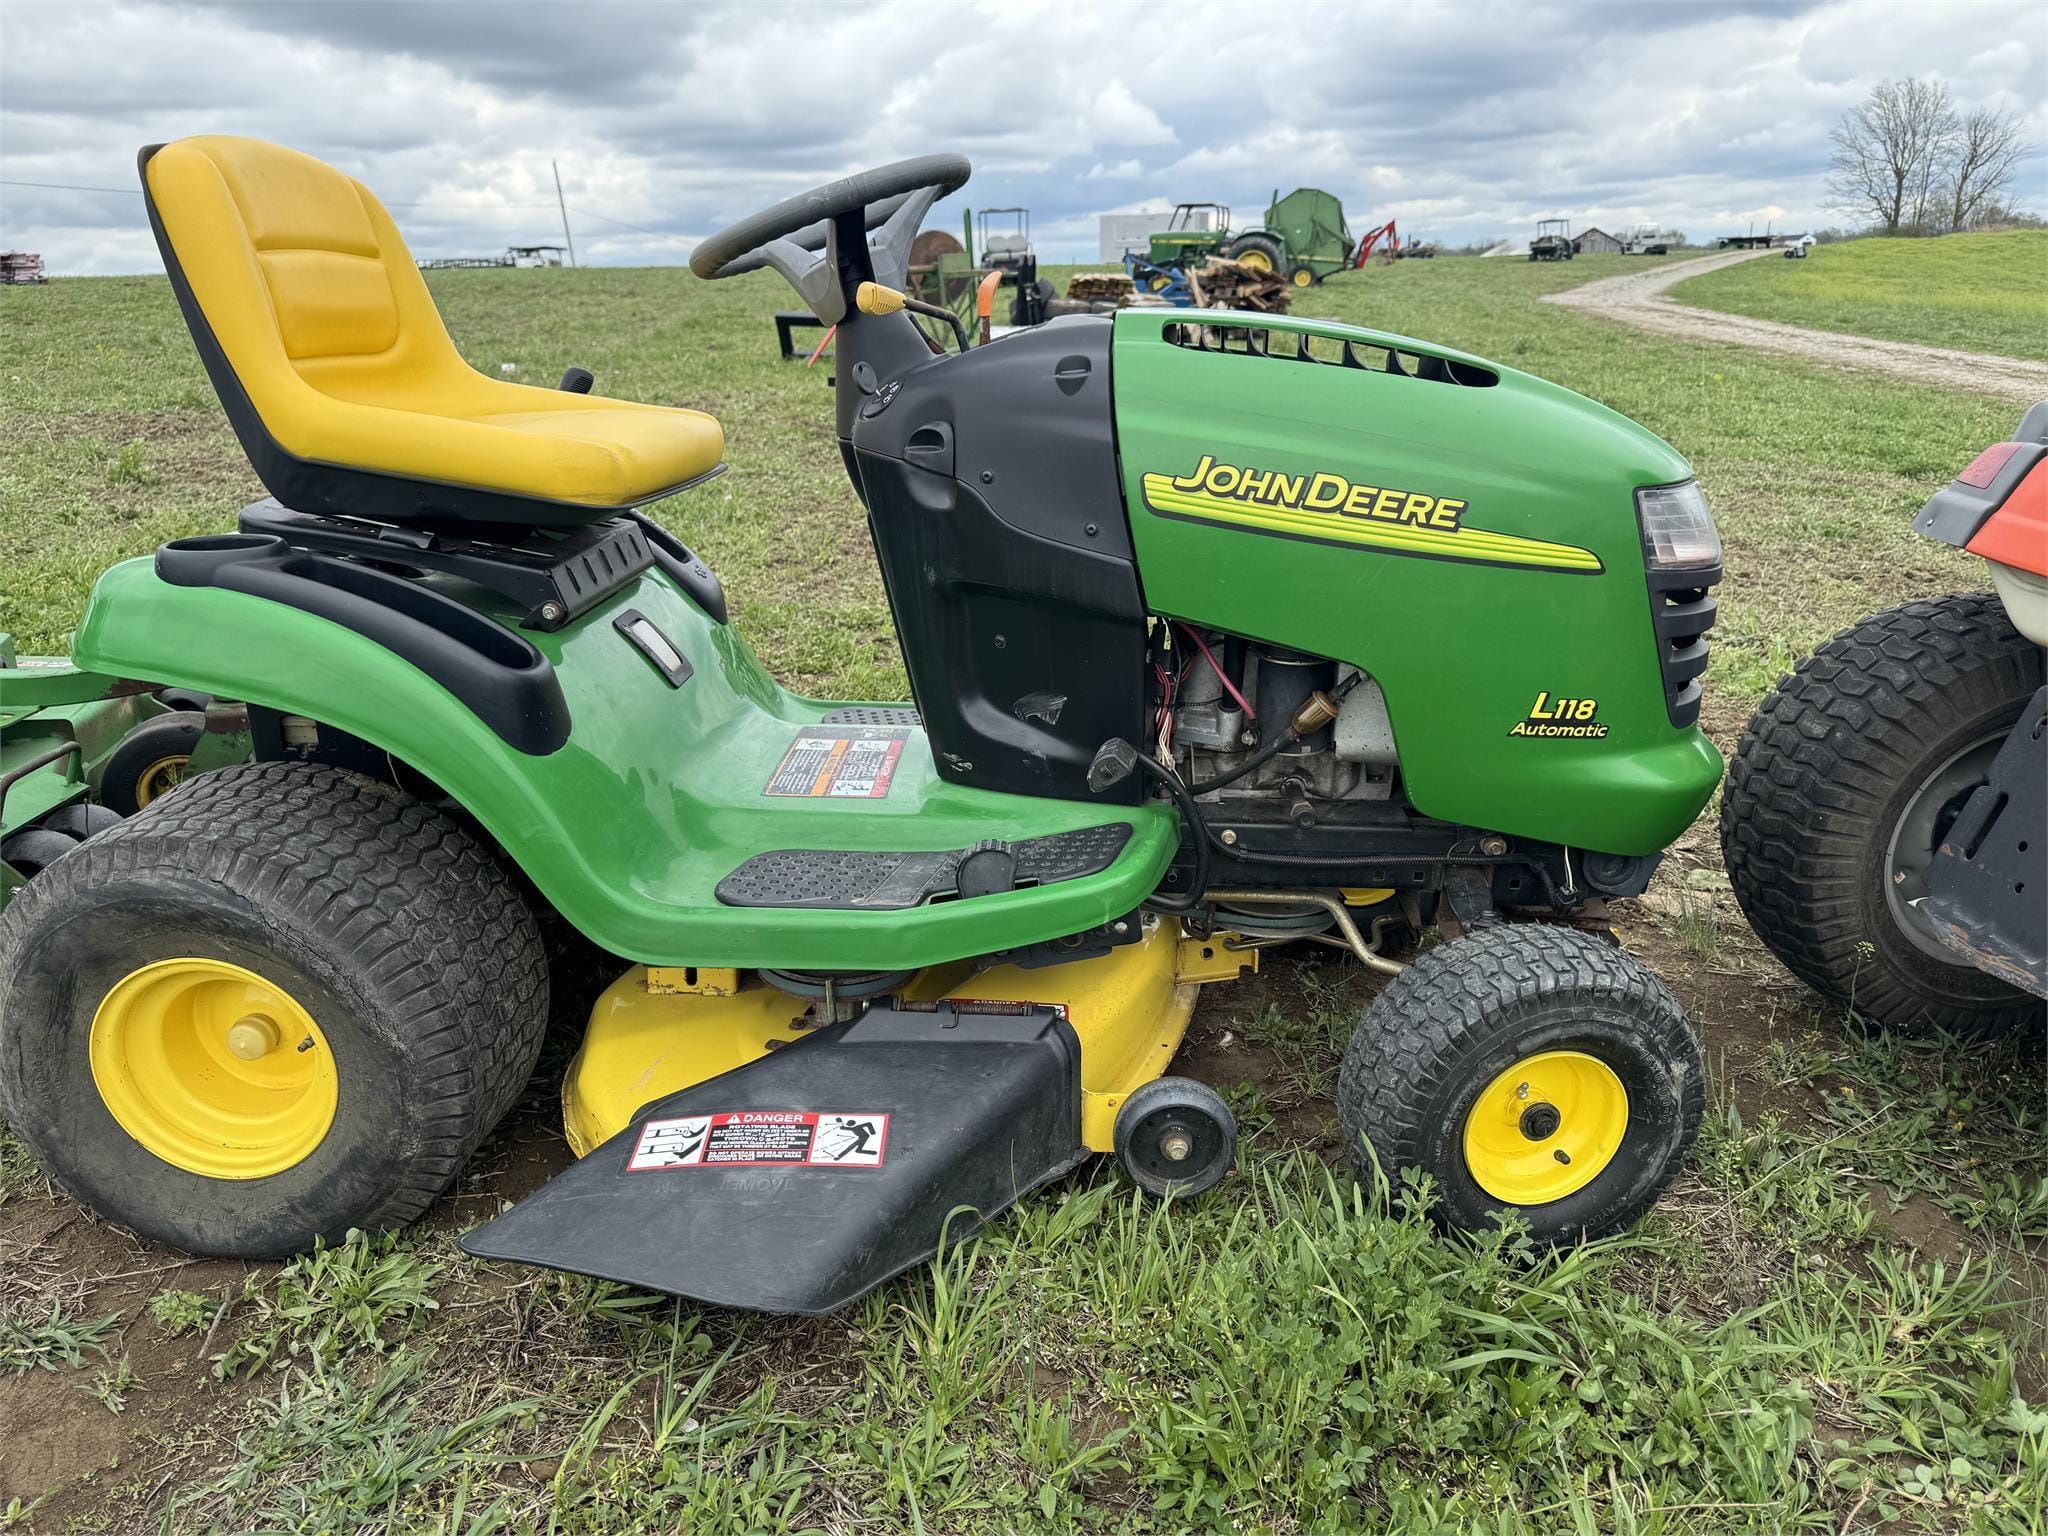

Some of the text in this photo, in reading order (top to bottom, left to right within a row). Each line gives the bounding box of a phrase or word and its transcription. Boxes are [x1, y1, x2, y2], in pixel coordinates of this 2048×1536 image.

[1174, 456, 1467, 530] JOHN DEERE
[1529, 692, 1598, 720] L118
[1510, 722, 1608, 738] Automatic
[743, 1113, 804, 1123] DANGER
